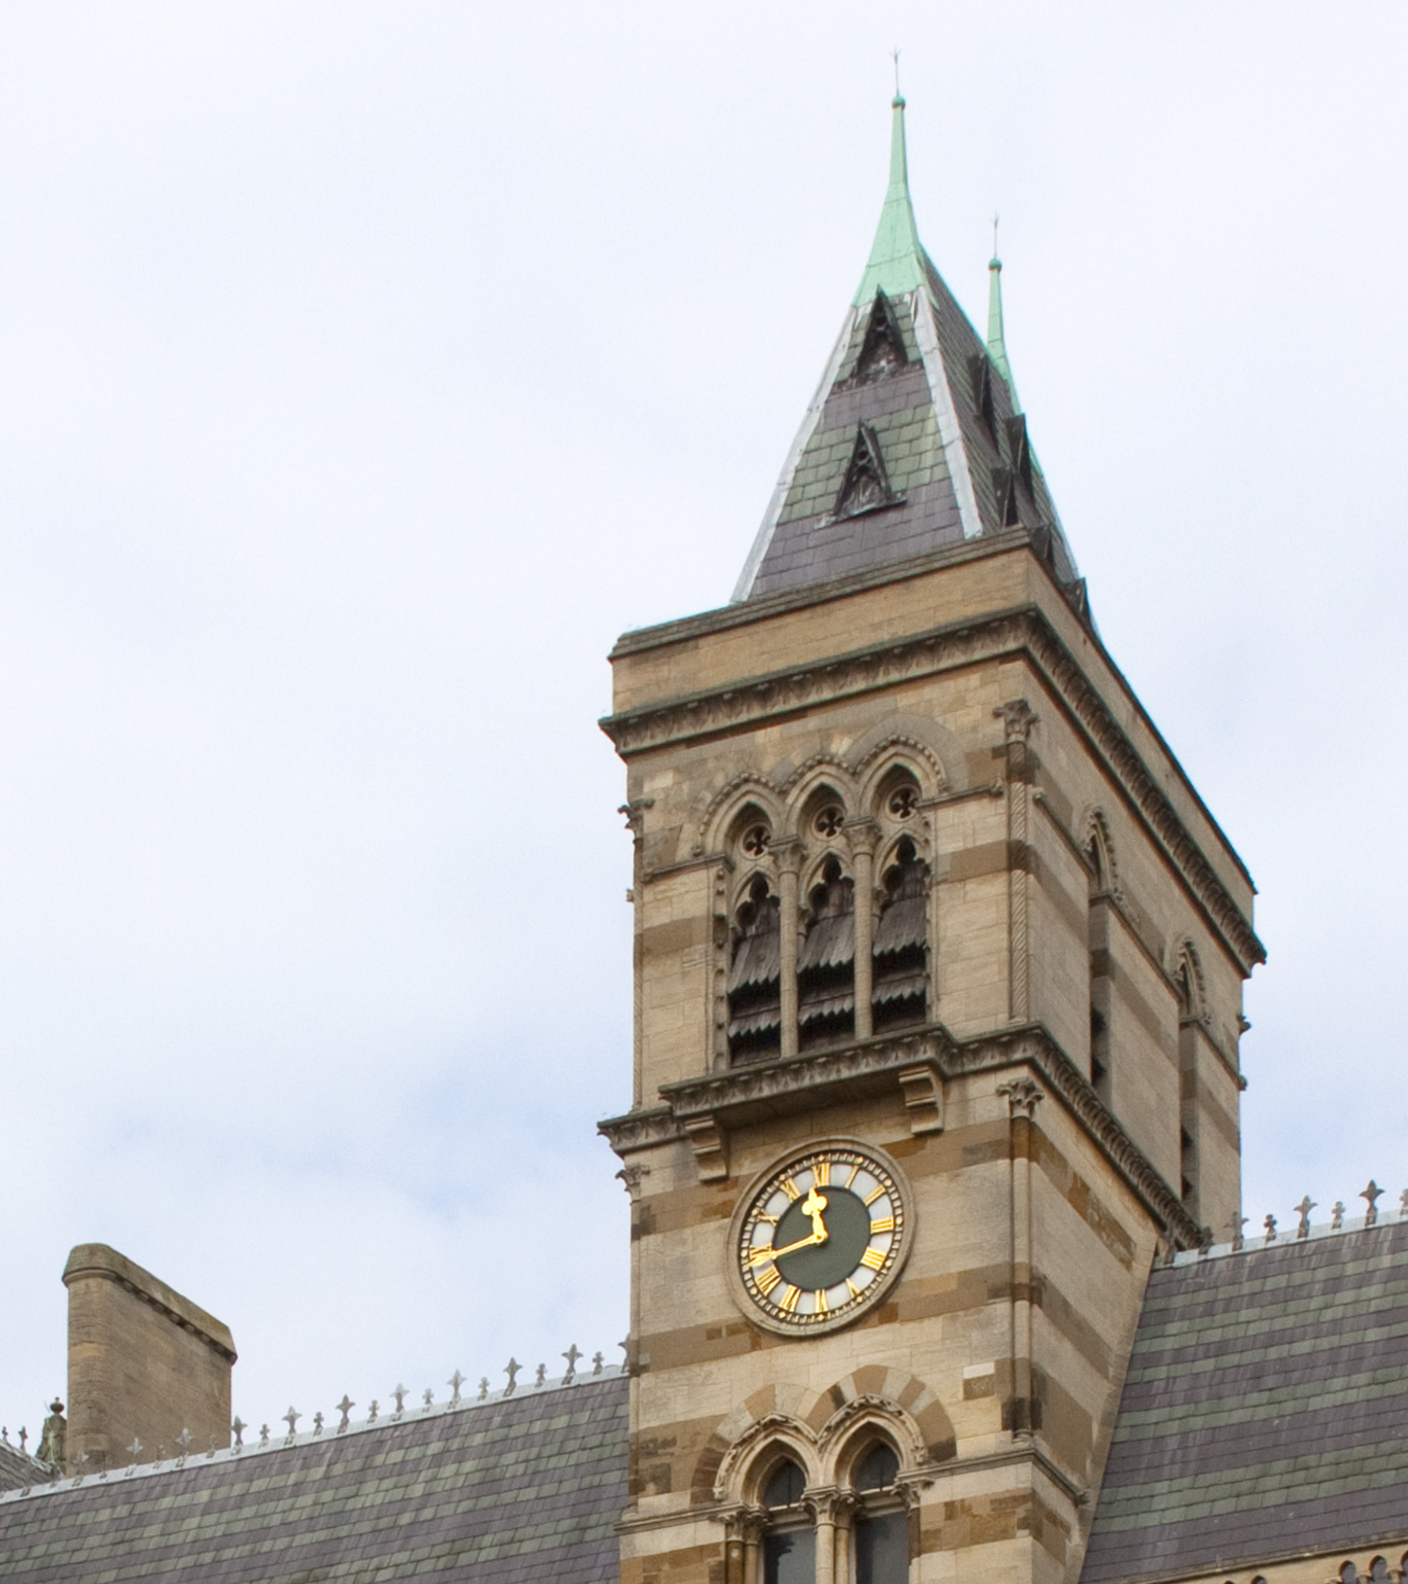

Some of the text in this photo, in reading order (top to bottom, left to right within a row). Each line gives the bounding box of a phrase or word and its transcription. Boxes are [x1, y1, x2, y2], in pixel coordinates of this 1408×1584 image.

[812, 1163, 831, 1187] XII
[844, 1165, 859, 1188] I
[779, 1177, 801, 1203] XI
[863, 1184, 885, 1207] II
[756, 1209, 780, 1226] X
[870, 1216, 894, 1234] III
[861, 1246, 887, 1270] IIII
[756, 1265, 781, 1296] VIII
[846, 1278, 861, 1298] V
[779, 1284, 801, 1312] VII
[815, 1288, 828, 1313] VI
